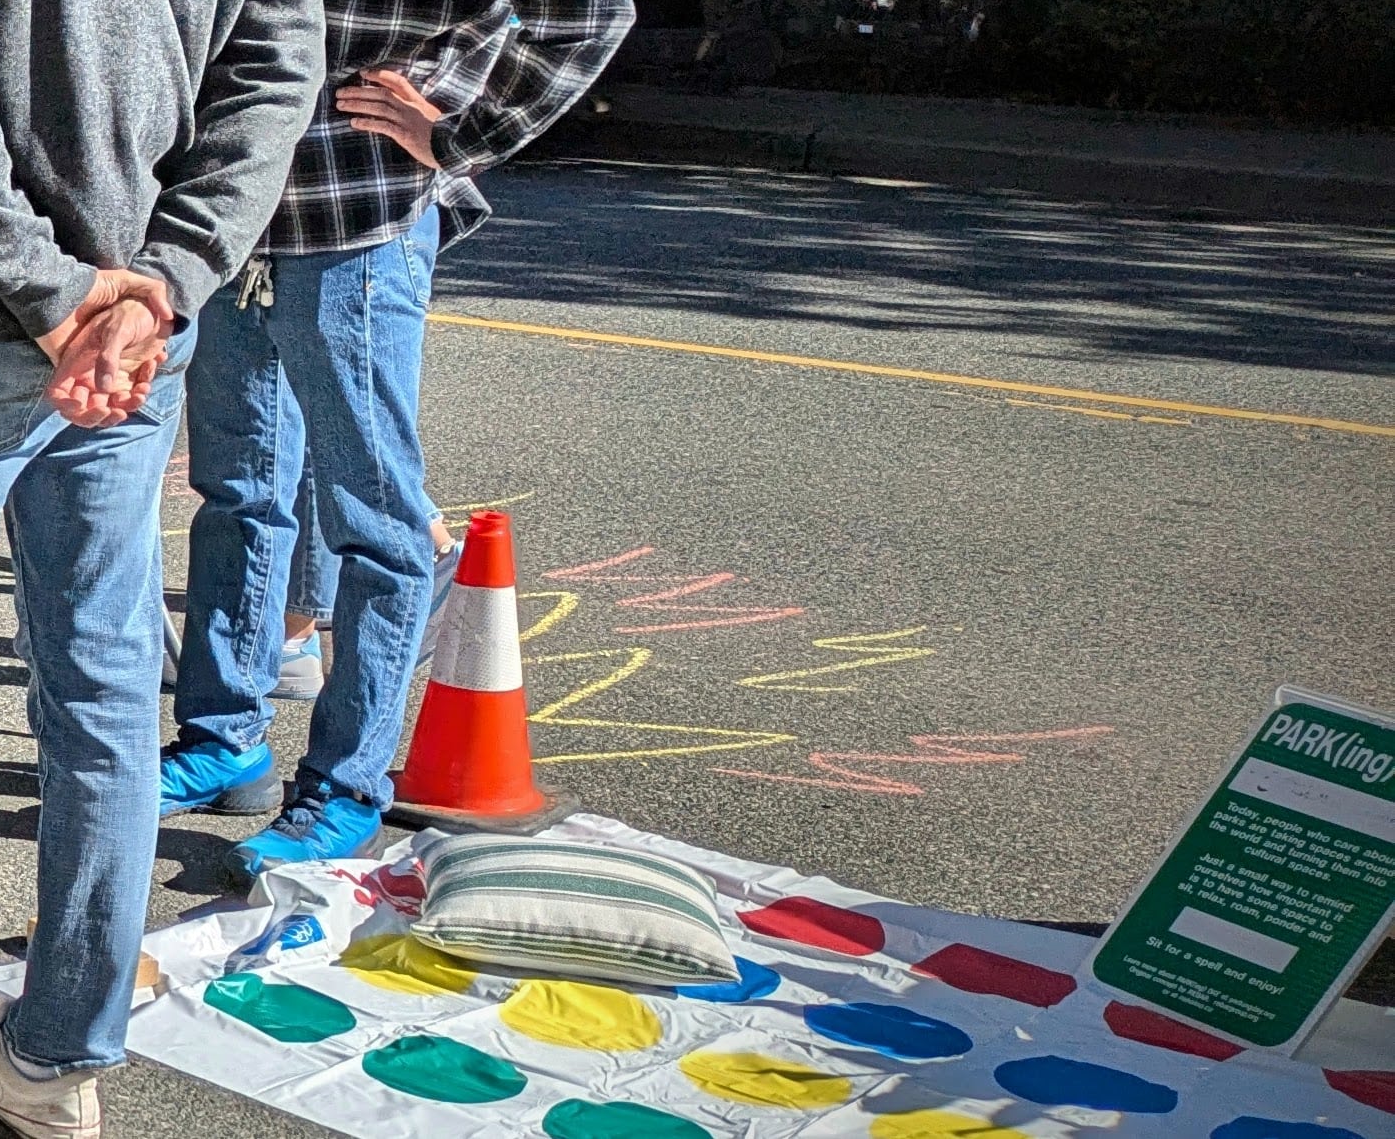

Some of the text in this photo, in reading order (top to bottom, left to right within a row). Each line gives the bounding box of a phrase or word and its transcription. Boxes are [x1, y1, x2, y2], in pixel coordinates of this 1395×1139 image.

[1209, 820, 1387, 887] the world and turning them into
[1213, 811, 1247, 827] parks
[1249, 823, 1268, 834] are
[1270, 829, 1307, 849] taking
[1309, 843, 1351, 862] spaces
[1228, 800, 1261, 822] Today,
[1263, 816, 1303, 834] people
[1307, 830, 1331, 842] who
[1333, 840, 1361, 853] care
[1194, 864, 1345, 922] ourselves how important it
[1199, 852, 1225, 868] Just
[1237, 867, 1269, 882] small
[1270, 878, 1293, 892] way
[1296, 886, 1309, 898] to
[1311, 894, 1355, 913] remind
[1244, 846, 1331, 882] cultural spaces.
[1177, 882, 1333, 944] sit, relax, roam, ponder and
[1189, 872, 1333, 932] is to have some space to
[1145, 936, 1285, 996] Sit for a spell and enjoy!
